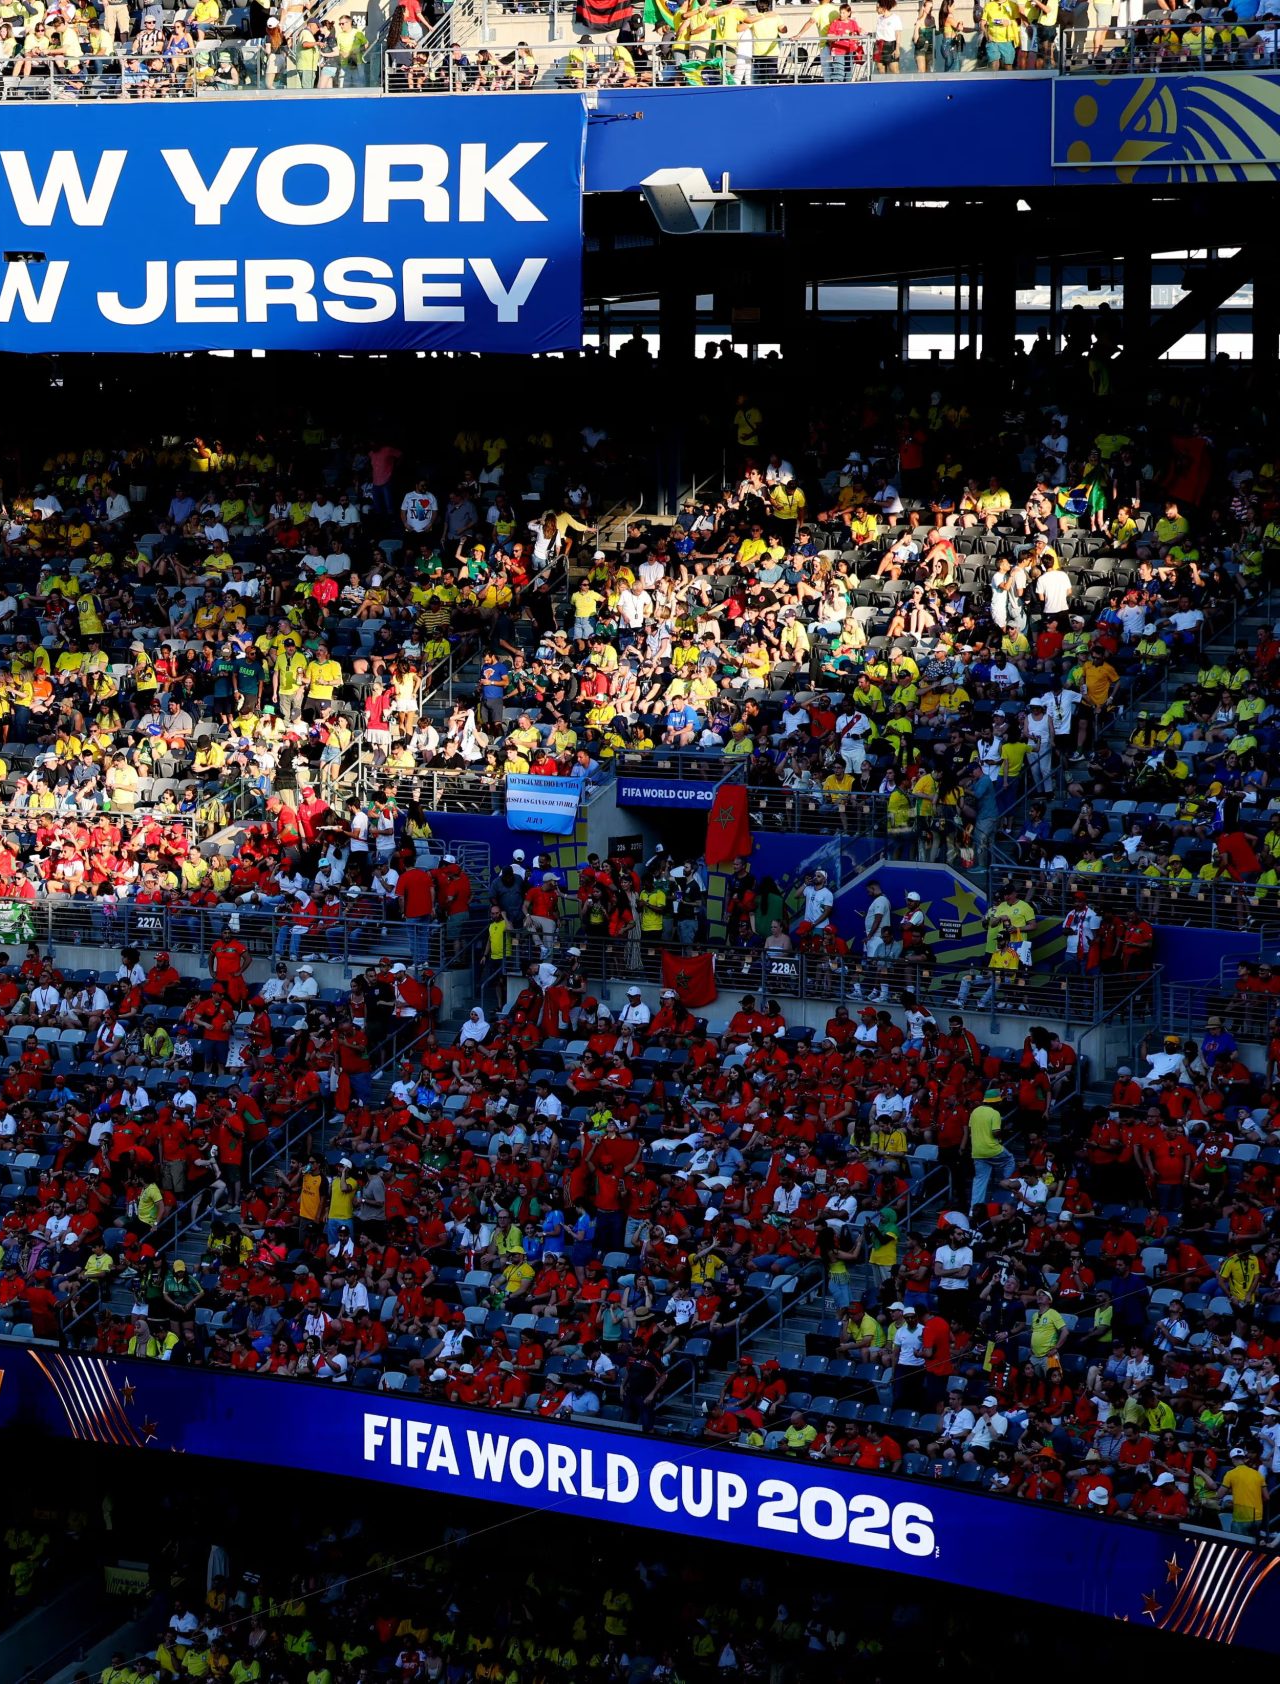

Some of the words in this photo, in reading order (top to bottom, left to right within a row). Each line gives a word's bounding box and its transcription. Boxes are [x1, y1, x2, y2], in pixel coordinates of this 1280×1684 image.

[161, 142, 549, 225] YORK
[97, 257, 548, 325] JERSEY
[622, 787, 641, 797] FIFA
[643, 788, 675, 799] WORLD
[677, 790, 695, 800] CUP
[696, 791, 714, 801] 20
[137, 917, 162, 928] 227A
[771, 962, 797, 975] 228A
[363, 1412, 459, 1475] FIFA
[466, 1430, 639, 1503] WORLD
[649, 1461, 748, 1522] CUP
[758, 1480, 935, 1557] 2026
